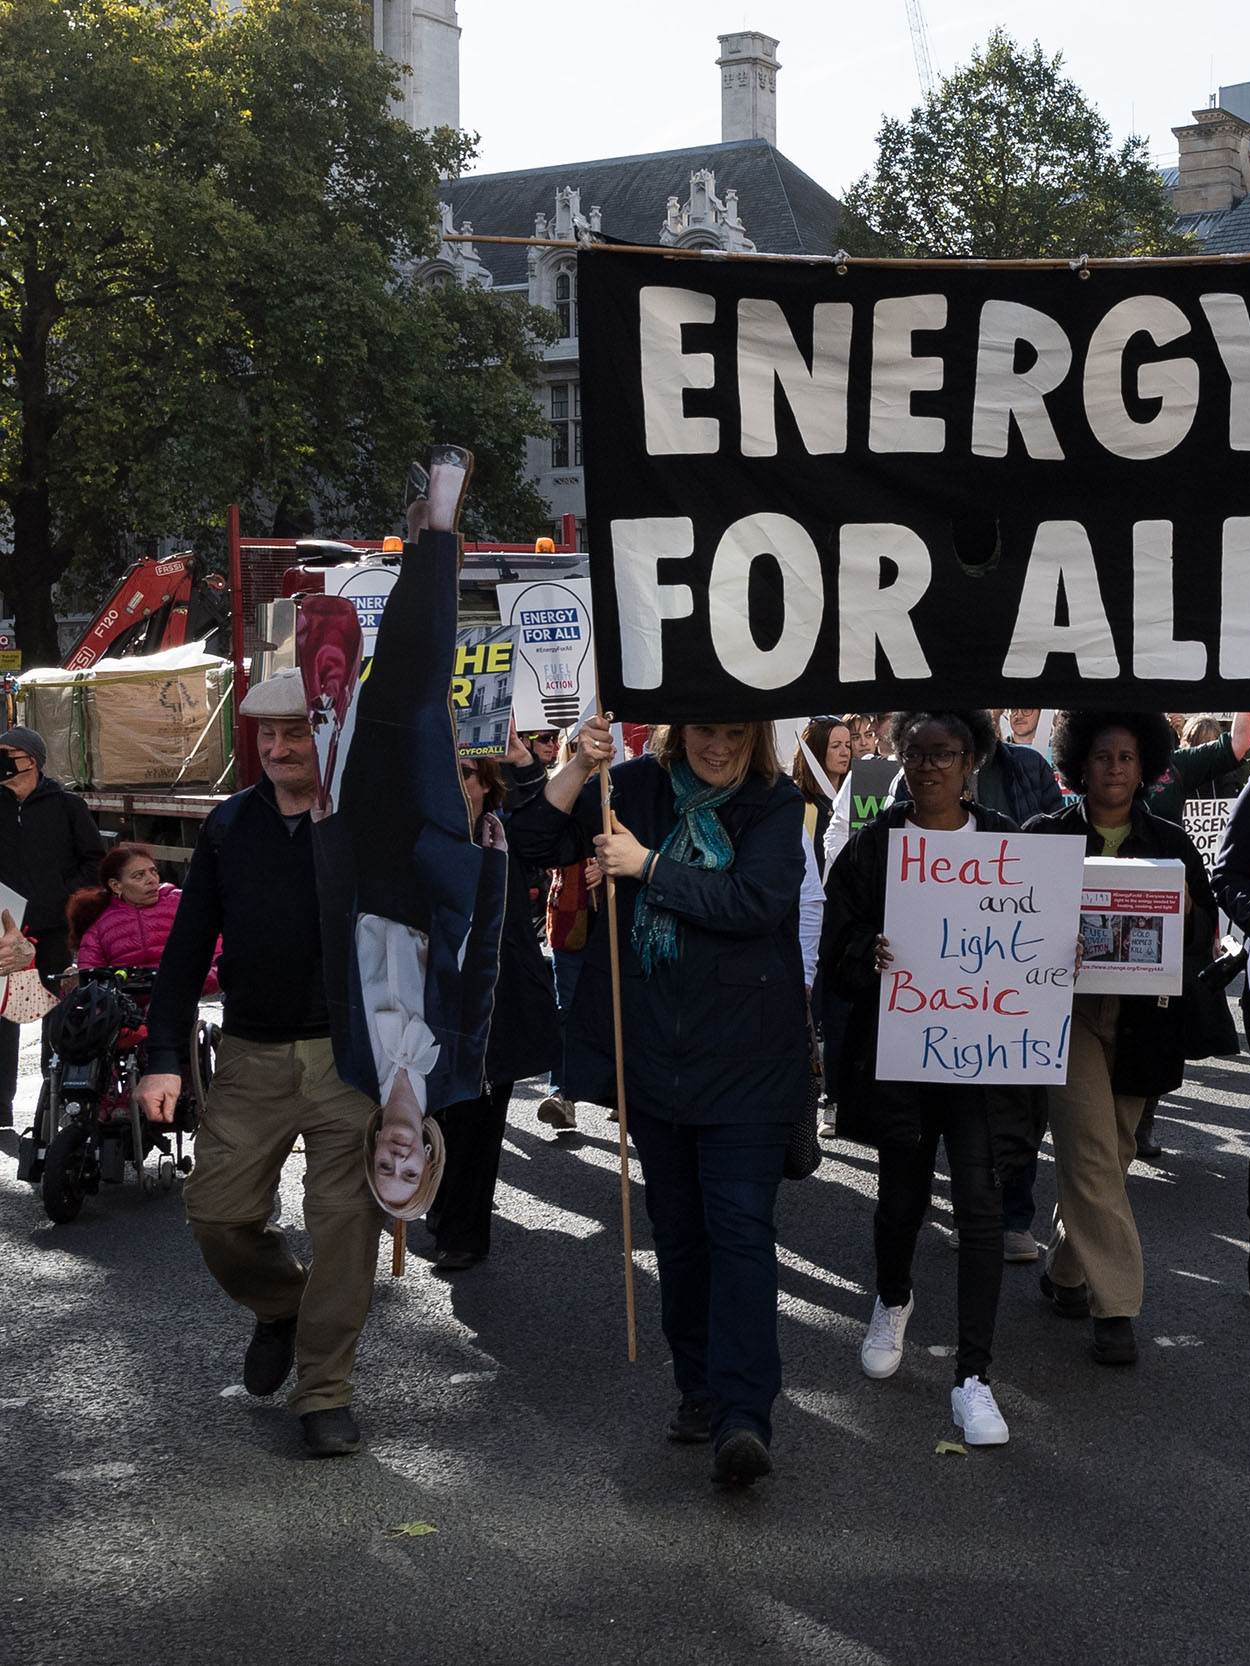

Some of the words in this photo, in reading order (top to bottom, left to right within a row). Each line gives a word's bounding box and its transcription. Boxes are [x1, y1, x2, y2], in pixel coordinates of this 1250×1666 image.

[158, 563, 182, 574] FASSI
[610, 512, 933, 690] FOR
[94, 608, 119, 638] F120
[359, 615, 375, 626] OR
[522, 610, 575, 625] ENERGY
[525, 629, 551, 643] FOR
[555, 627, 579, 641] ALL
[536, 645, 572, 653] #EnergyForAll
[544, 663, 571, 674] FUEL
[546, 680, 573, 690] ACTION
[1183, 800, 1231, 818] THEIR
[901, 835, 1024, 885] Heat
[979, 886, 1041, 913] and
[1083, 926, 1109, 938] FUEL
[1132, 930, 1150, 938] COLD
[940, 918, 1044, 973] Light
[1026, 967, 1069, 987] are
[888, 970, 1029, 1015] Basic
[922, 1015, 1070, 1078] Rights!
